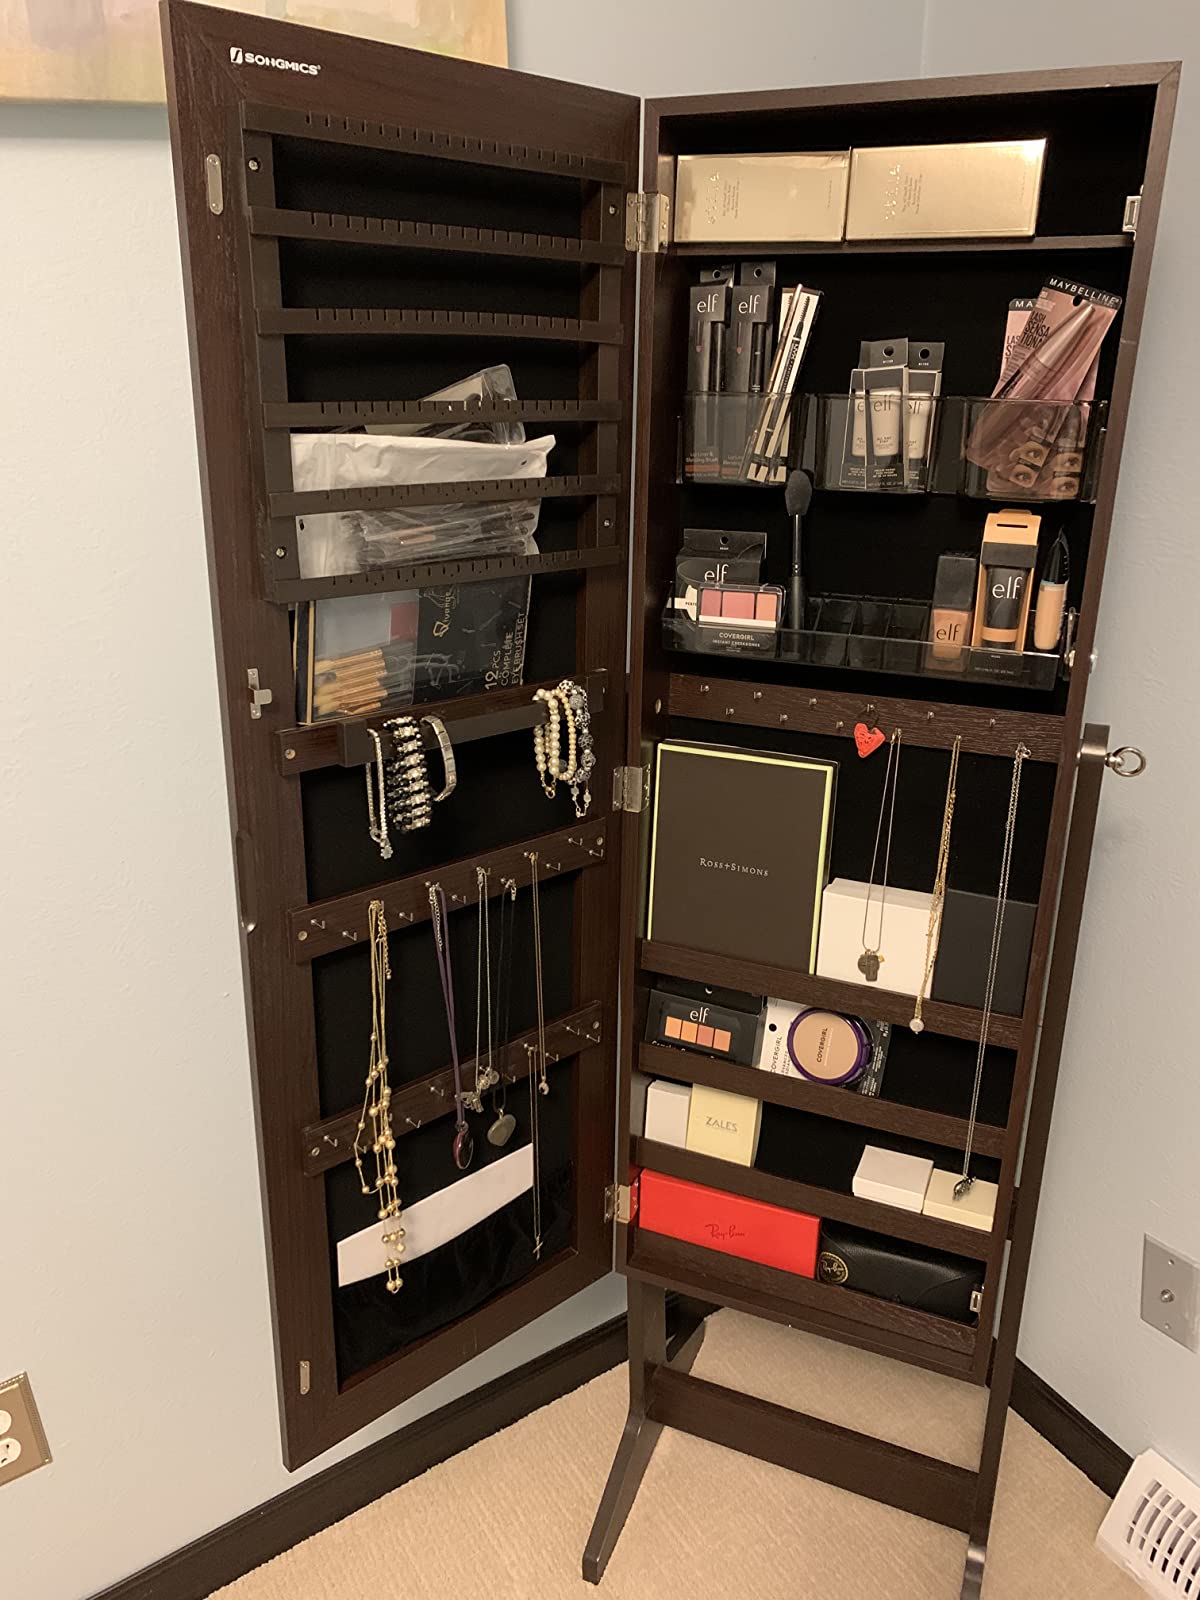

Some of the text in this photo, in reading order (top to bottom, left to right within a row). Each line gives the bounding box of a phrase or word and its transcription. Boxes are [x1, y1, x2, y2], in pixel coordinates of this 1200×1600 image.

[1050, 277, 1117, 306] MAYBELLINE
[696, 294, 719, 314] elf
[738, 294, 761, 314] elf
[1030, 311, 1047, 324] LASH
[992, 576, 1023, 600] elf
[719, 632, 755, 642] COVERGIRL
[936, 623, 961, 642] elf
[500, 631, 514, 687] COMPLETE
[485, 650, 502, 691] 12 PCS
[689, 1006, 711, 1024] elf
[815, 1027, 829, 1063] COVERGIRL
[705, 1115, 738, 1132] ZALES
